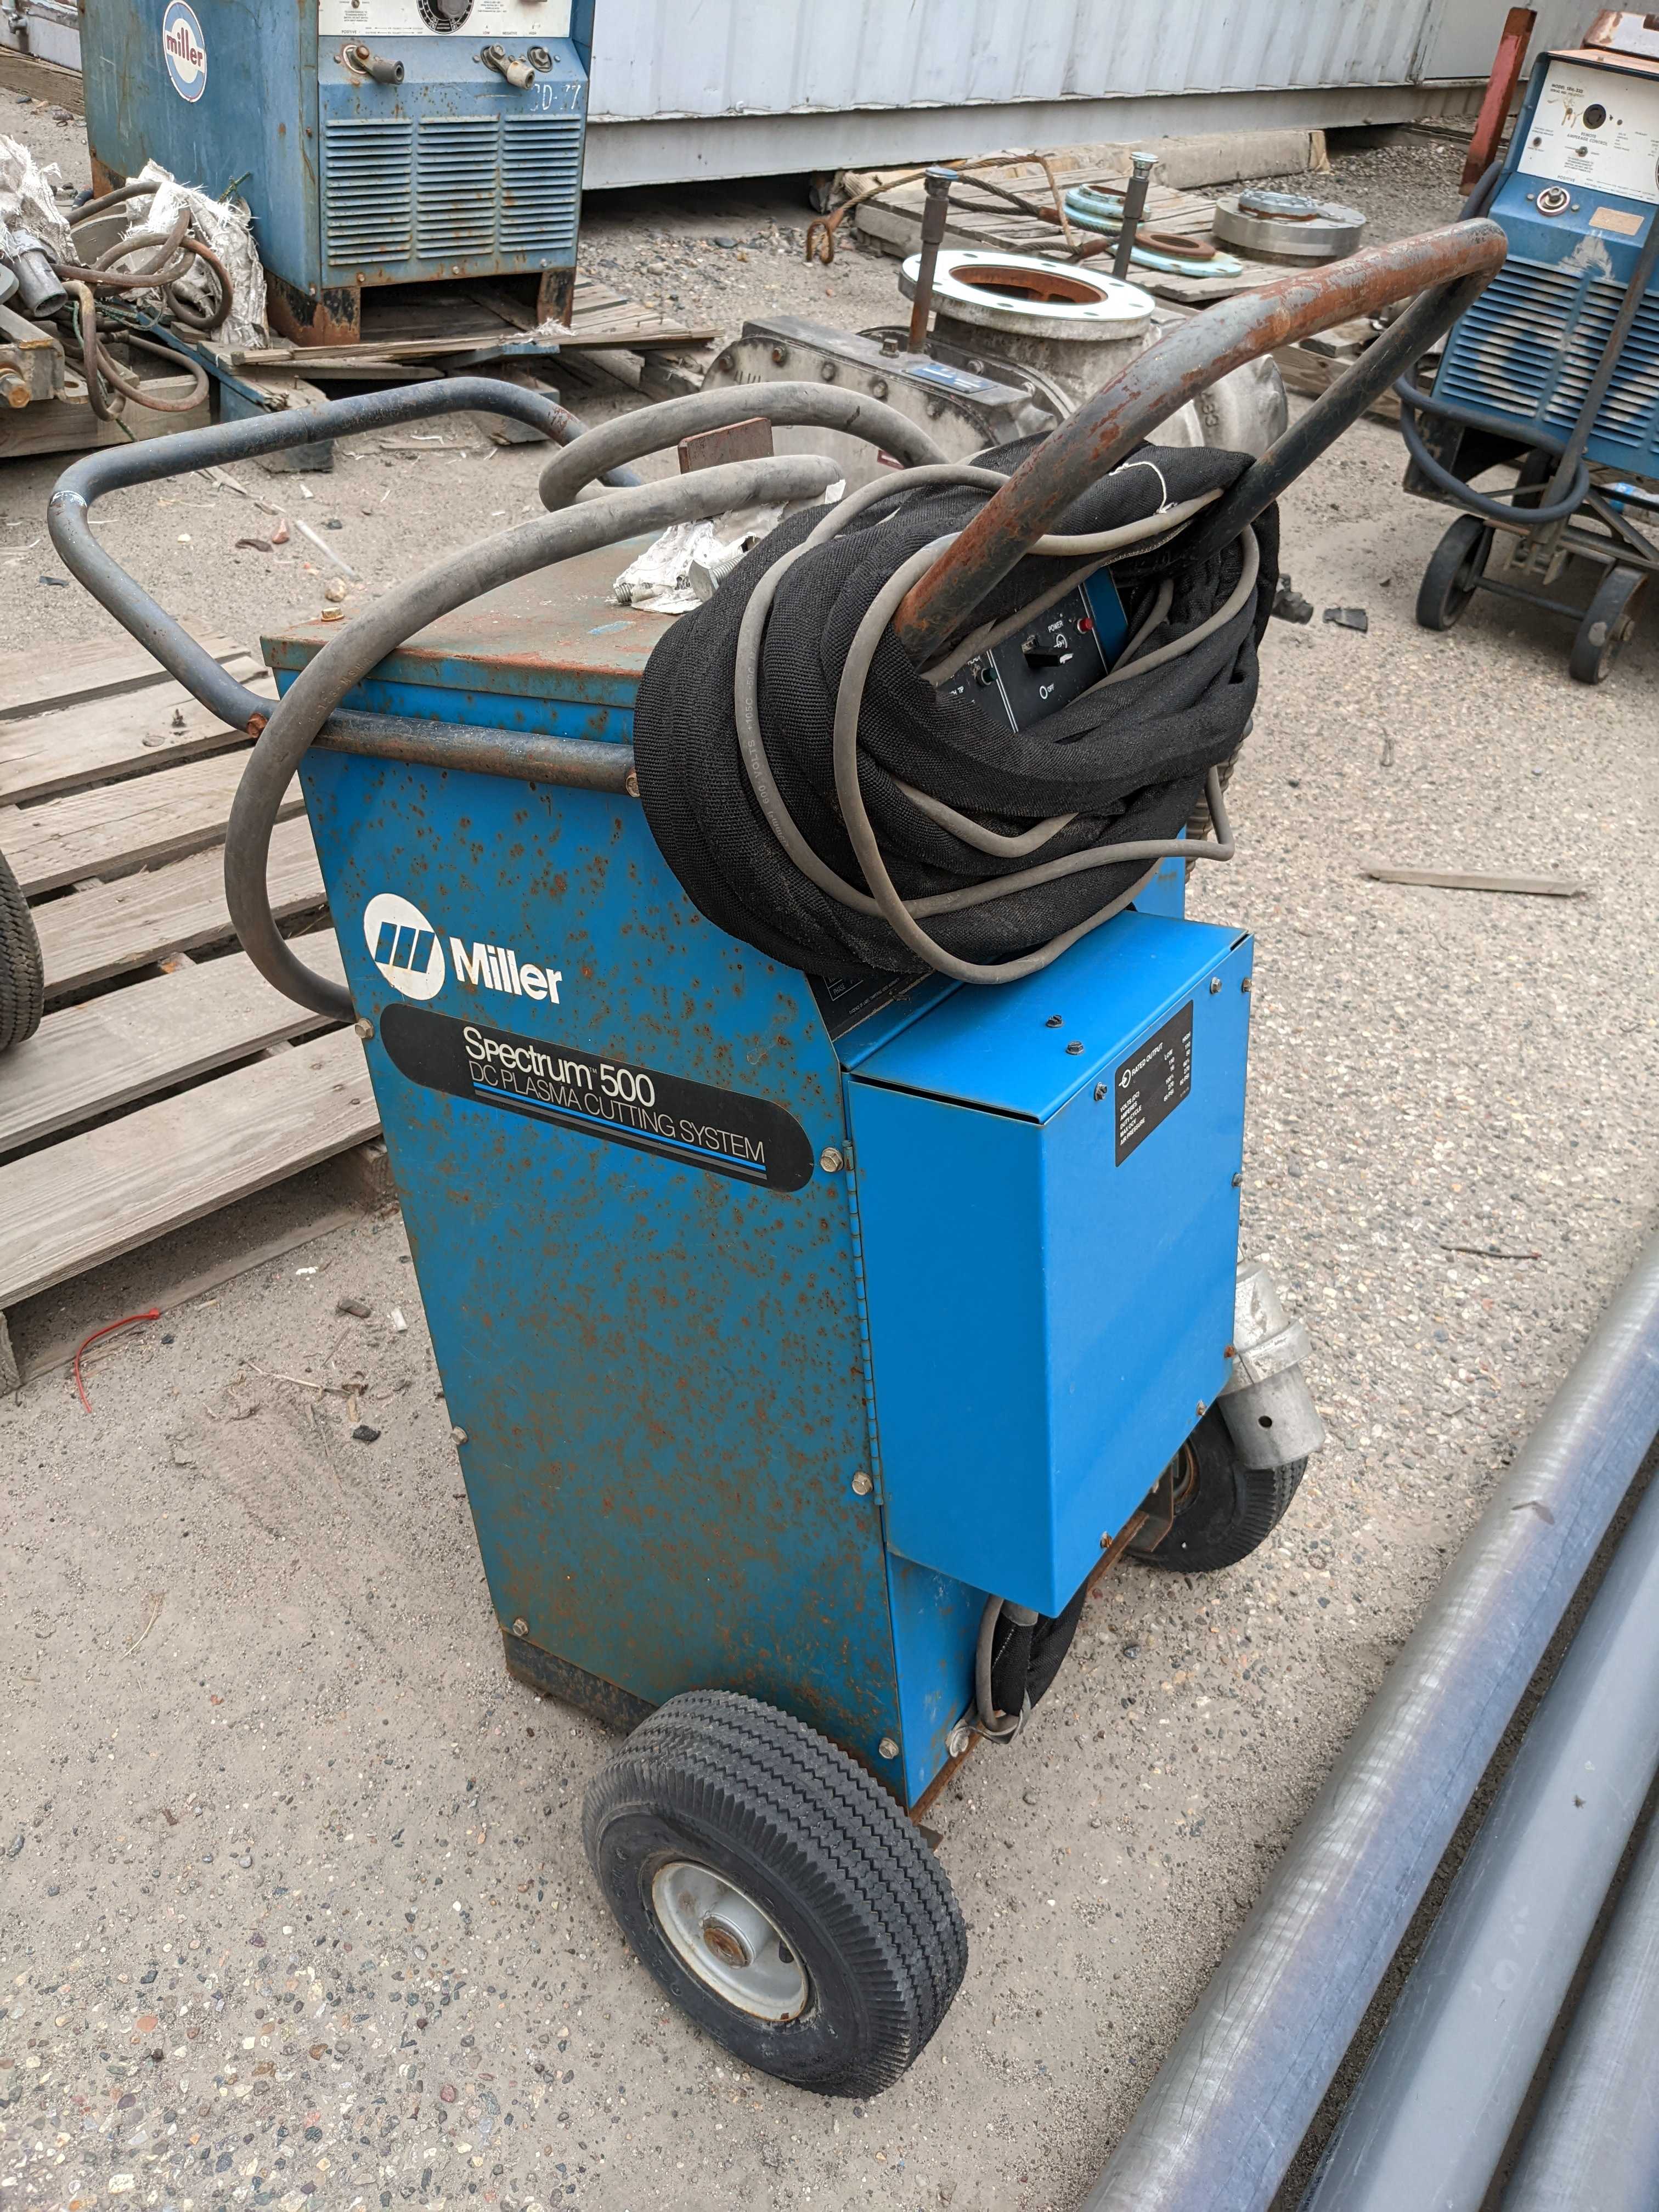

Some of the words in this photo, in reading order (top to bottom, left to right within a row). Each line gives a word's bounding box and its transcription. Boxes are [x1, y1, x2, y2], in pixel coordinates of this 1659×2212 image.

[166, 27, 203, 67] miller
[1048, 620, 1064, 633] POWER
[747, 666, 757, 690] -50C
[745, 697, 754, 731] +105C
[748, 740, 762, 778] VOLTS
[759, 785, 769, 804] 600
[449, 936, 562, 1005] Miller
[832, 983, 847, 996] PHASE
[1131, 1059, 1146, 1076] RATED
[1146, 1042, 1163, 1062] OUTPUT
[1164, 1049, 1173, 1060] LOW
[1182, 1031, 1190, 1043] HIGH
[464, 1026, 593, 1091] Spectrum
[600, 1063, 656, 1108] 500
[469, 1060, 498, 1086] DC
[501, 1069, 582, 1111] PLASMA
[584, 1093, 676, 1138] CUTTING
[680, 1120, 765, 1164] SYSTEM
[1120, 1116, 1129, 1130] DUTY
[1130, 1105, 1142, 1119] CYCLE
[1166, 1074, 1174, 1084] 100%
[1120, 1098, 1131, 1113] VOLTS
[1120, 1101, 1137, 1121] AMPERES
[1120, 1127, 1128, 1138] MAX
[1128, 1118, 1137, 1130] OCV
[1127, 1116, 1146, 1139] PRESSURE
